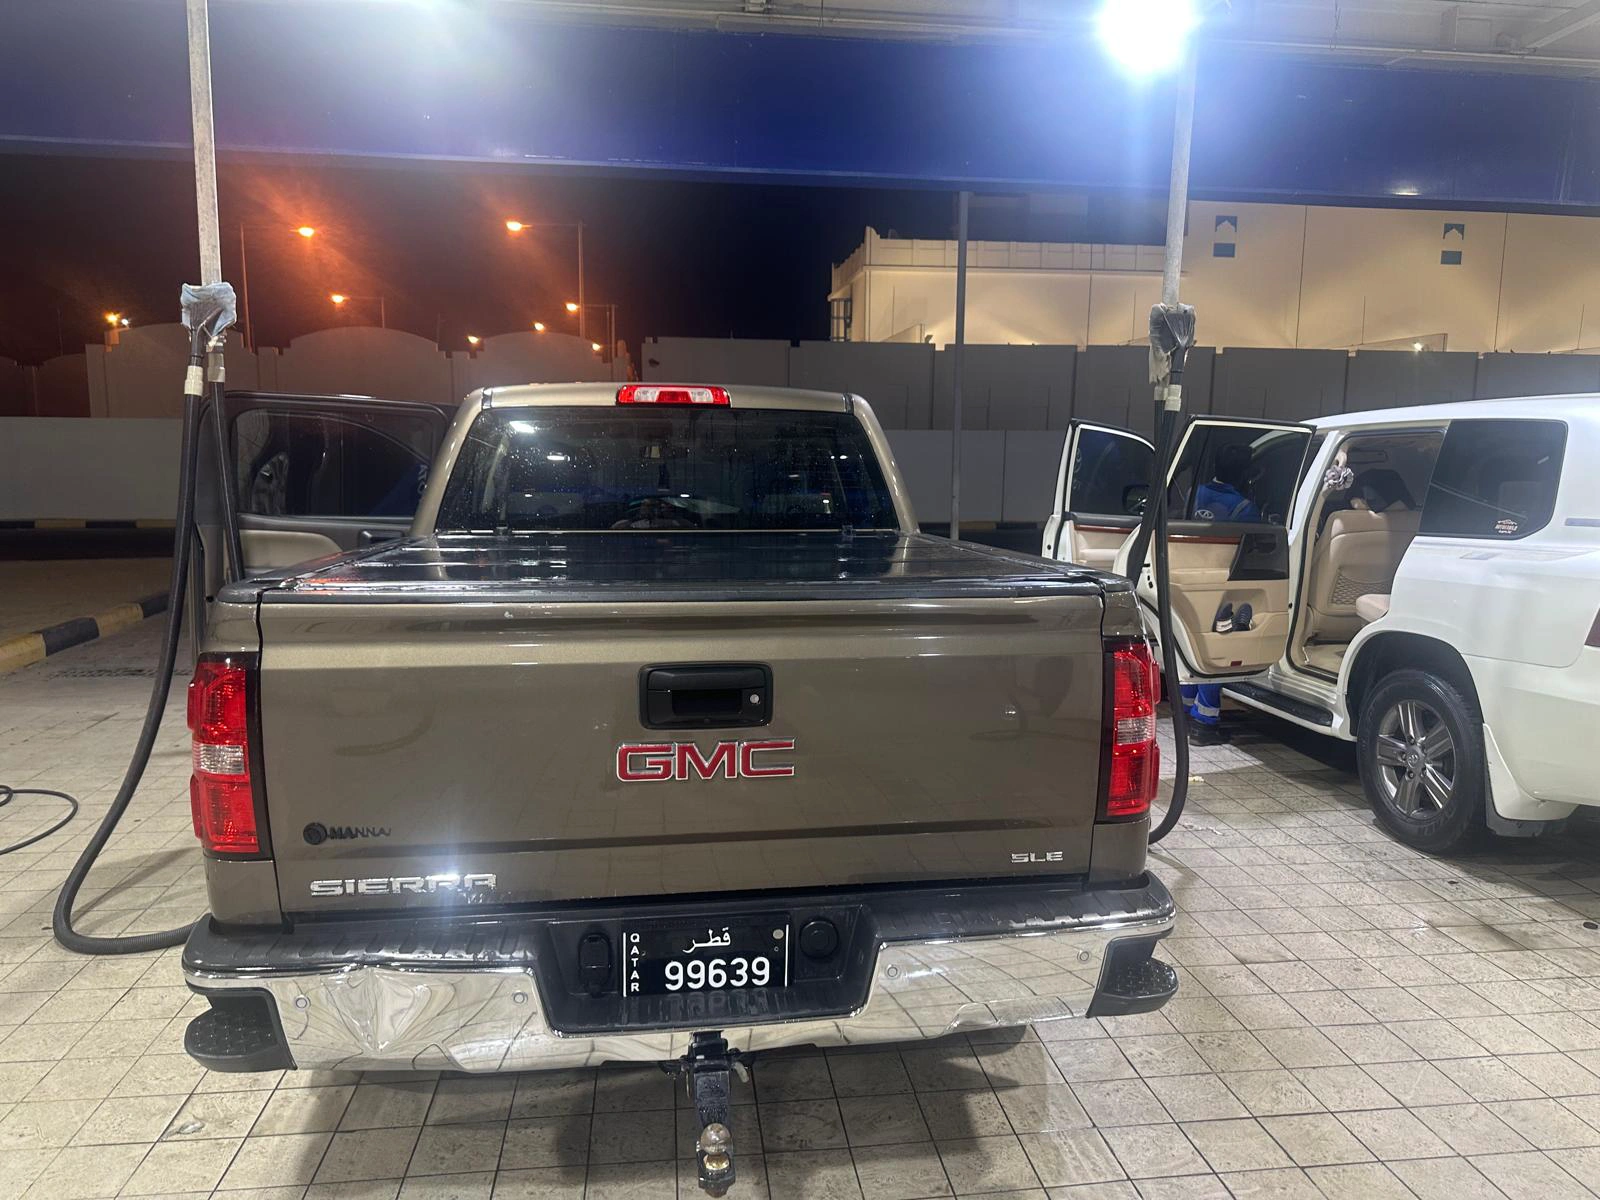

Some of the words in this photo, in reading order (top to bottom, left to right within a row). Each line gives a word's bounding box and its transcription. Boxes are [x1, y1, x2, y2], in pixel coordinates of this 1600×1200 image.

[616, 739, 795, 782] GMC
[1011, 851, 1064, 863] SLE
[309, 873, 497, 897] SIERRA
[682, 927, 731, 953] قطر
[629, 933, 641, 992] QATAR
[664, 956, 770, 991] 99639
